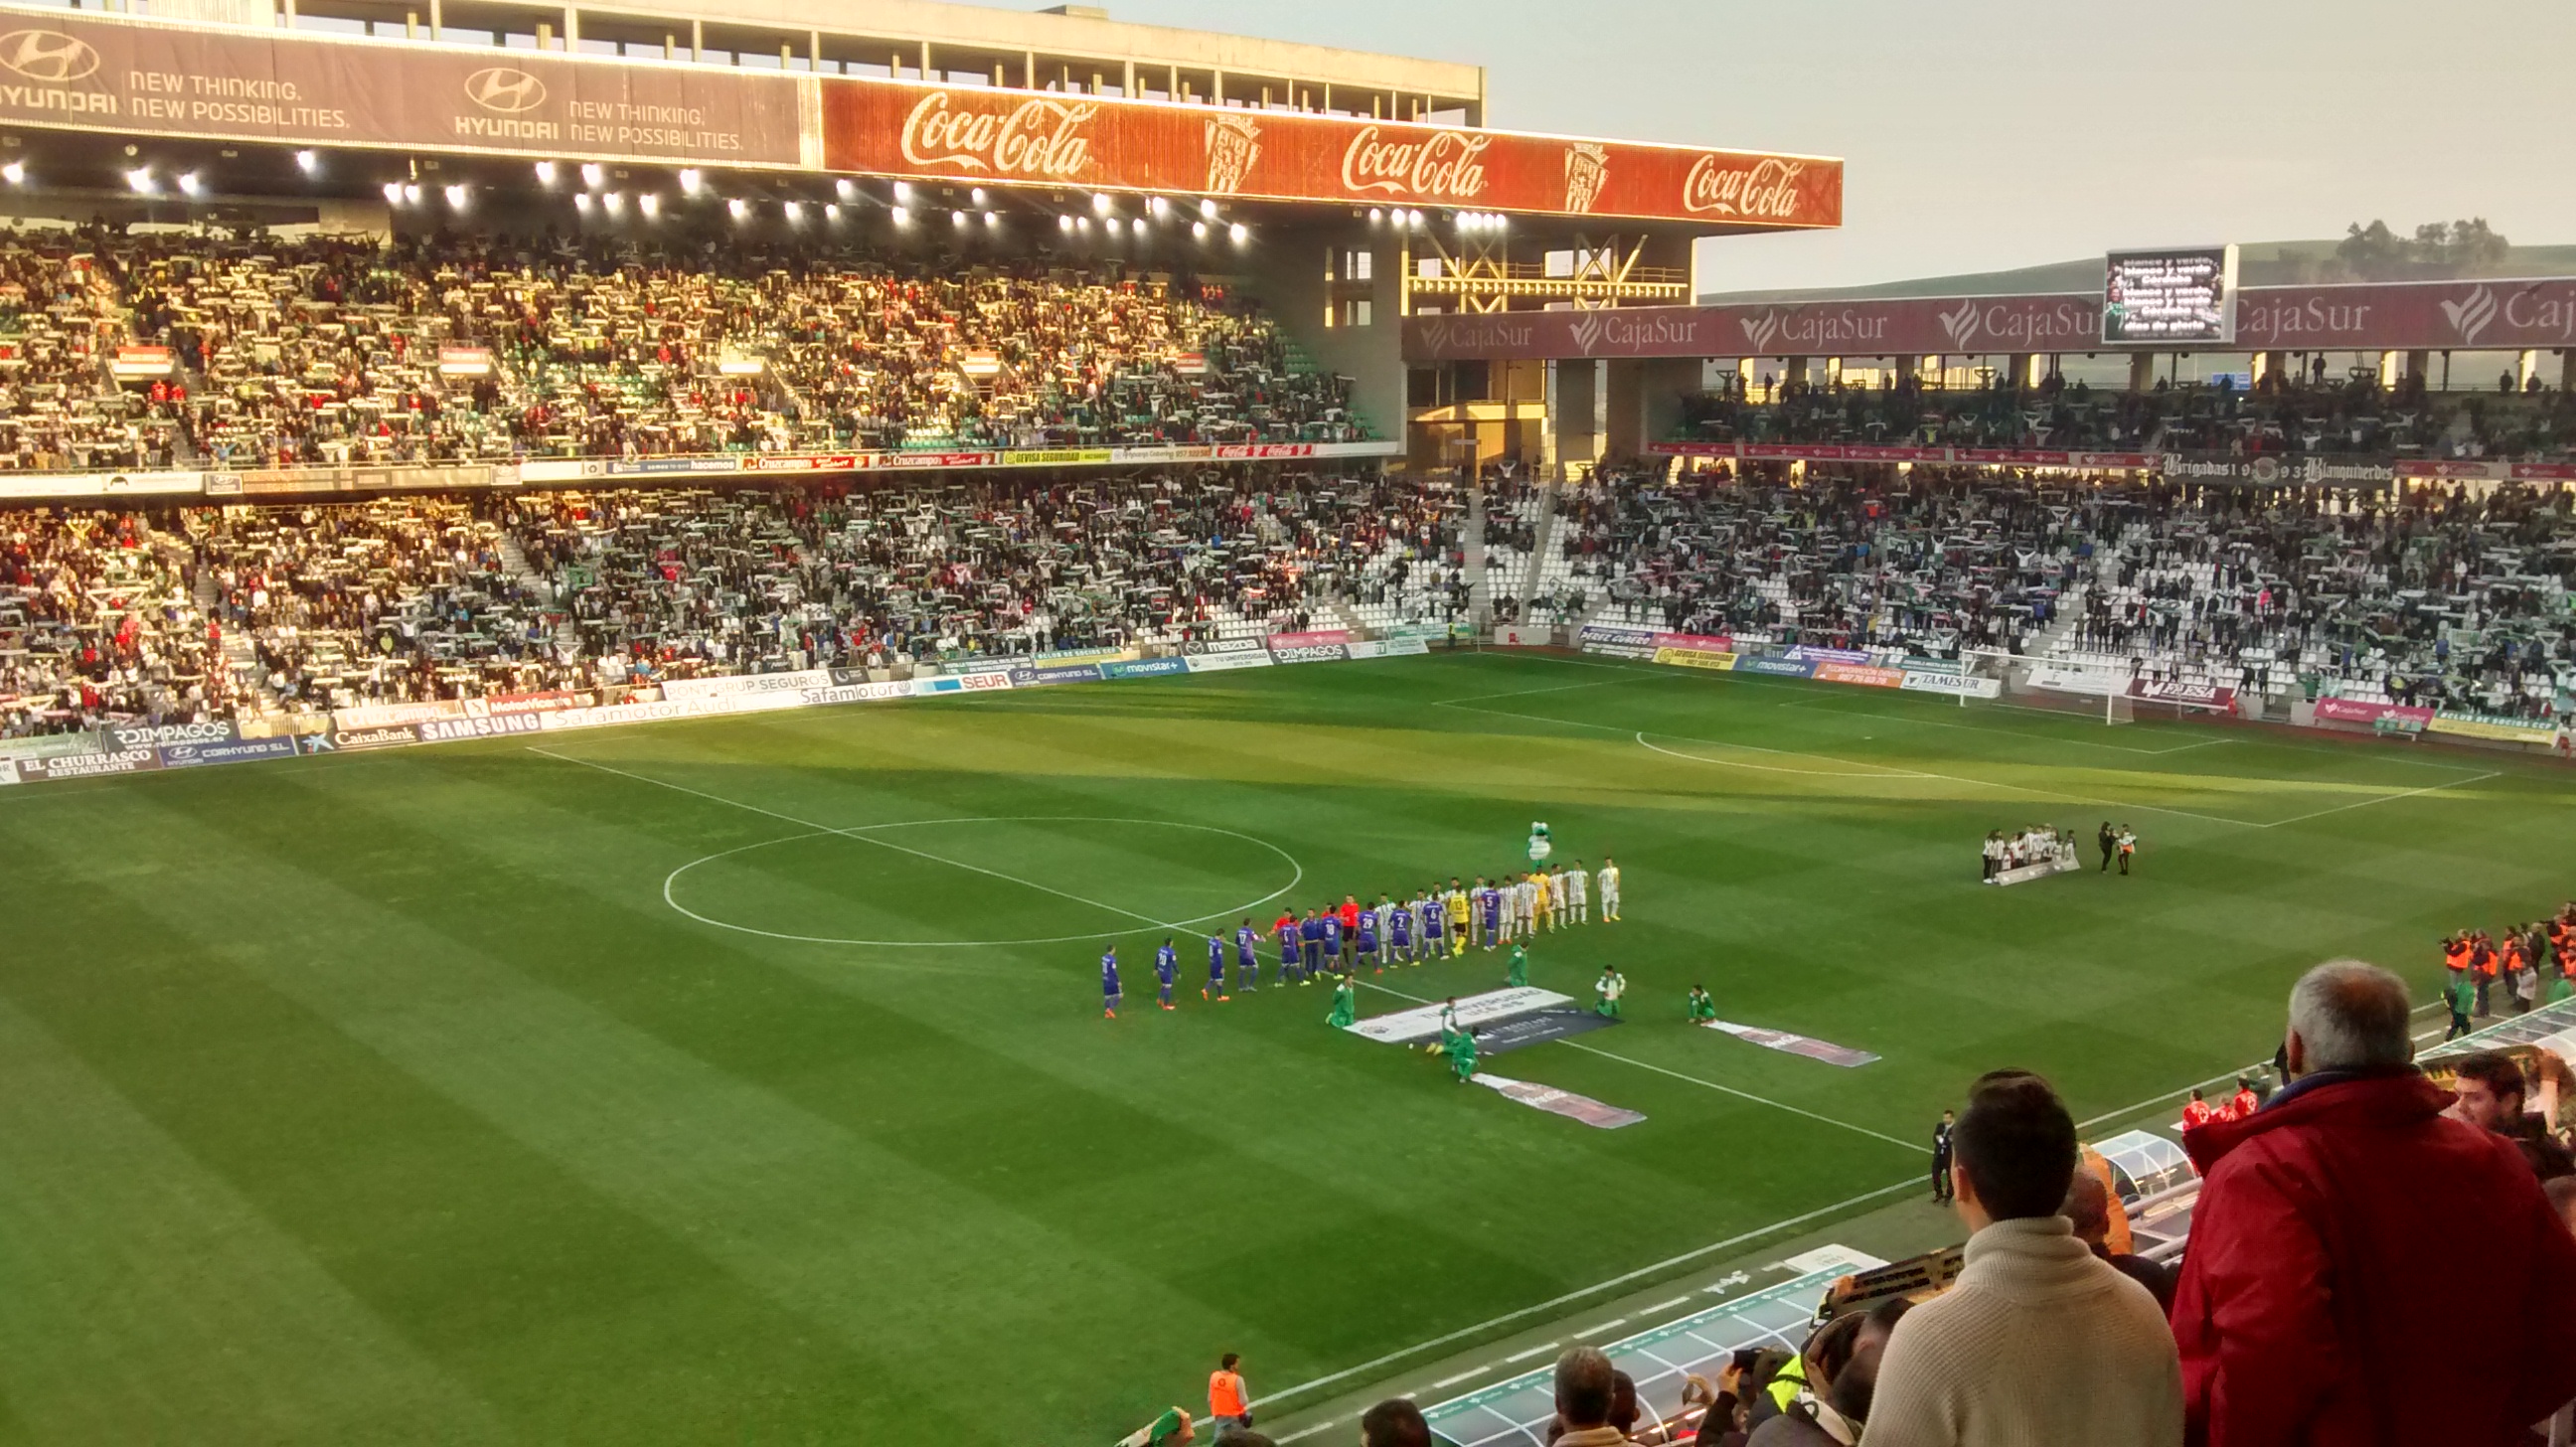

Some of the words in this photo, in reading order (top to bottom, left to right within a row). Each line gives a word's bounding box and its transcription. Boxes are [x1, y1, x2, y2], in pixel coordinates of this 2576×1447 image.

[131, 73, 183, 92] NEW
[190, 76, 302, 100] THINKING.
[0, 84, 117, 114] YUNDAI
[132, 97, 185, 118] NEW
[193, 101, 351, 128] POSSIBILITIES.
[570, 101, 613, 120] NEW
[455, 116, 559, 140] HYUNDAI
[570, 124, 613, 143] NEW
[619, 126, 743, 151] POSSIBILITIES.
[901, 91, 1096, 174] Coca-Cola
[1342, 125, 1491, 197] Coca-Cola
[1684, 154, 1805, 216] Coca-Cola
[2124, 267, 2165, 276] blanco
[2123, 288, 2163, 297] blanco
[1604, 315, 1697, 354] CajaSur
[1783, 310, 1887, 350] CajaSur
[1986, 305, 2103, 346] CajaSu
[2152, 321, 2168, 330] de
[1451, 321, 1531, 352] CajaSur
[691, 460, 734, 470] hacemos
[759, 458, 809, 469] Cruzcampo
[893, 455, 939, 466] Cruzcampo
[2162, 453, 2229, 476] Brigadas
[1208, 639, 1258, 653] mazda
[667, 684, 711, 696] PONT
[715, 681, 754, 694] GRUP
[759, 675, 829, 691] SEGUROS
[961, 674, 1008, 689] SEUR
[2162, 683, 2216, 699] FAESA
[800, 684, 893, 704] Safamotor
[556, 705, 684, 726] Safamotor
[688, 696, 736, 717] Audi
[2336, 706, 2367, 716] CajaSur
[421, 714, 539, 739] SAMSUNG
[2492, 718, 2528, 727] SOCIOS
[335, 727, 415, 744] CaixaBank
[23, 760, 46, 771] EL
[49, 749, 151, 768] CHURRASCO
[48, 761, 135, 777] RESTAURANTE
[1398, 916, 1404, 927] 2
